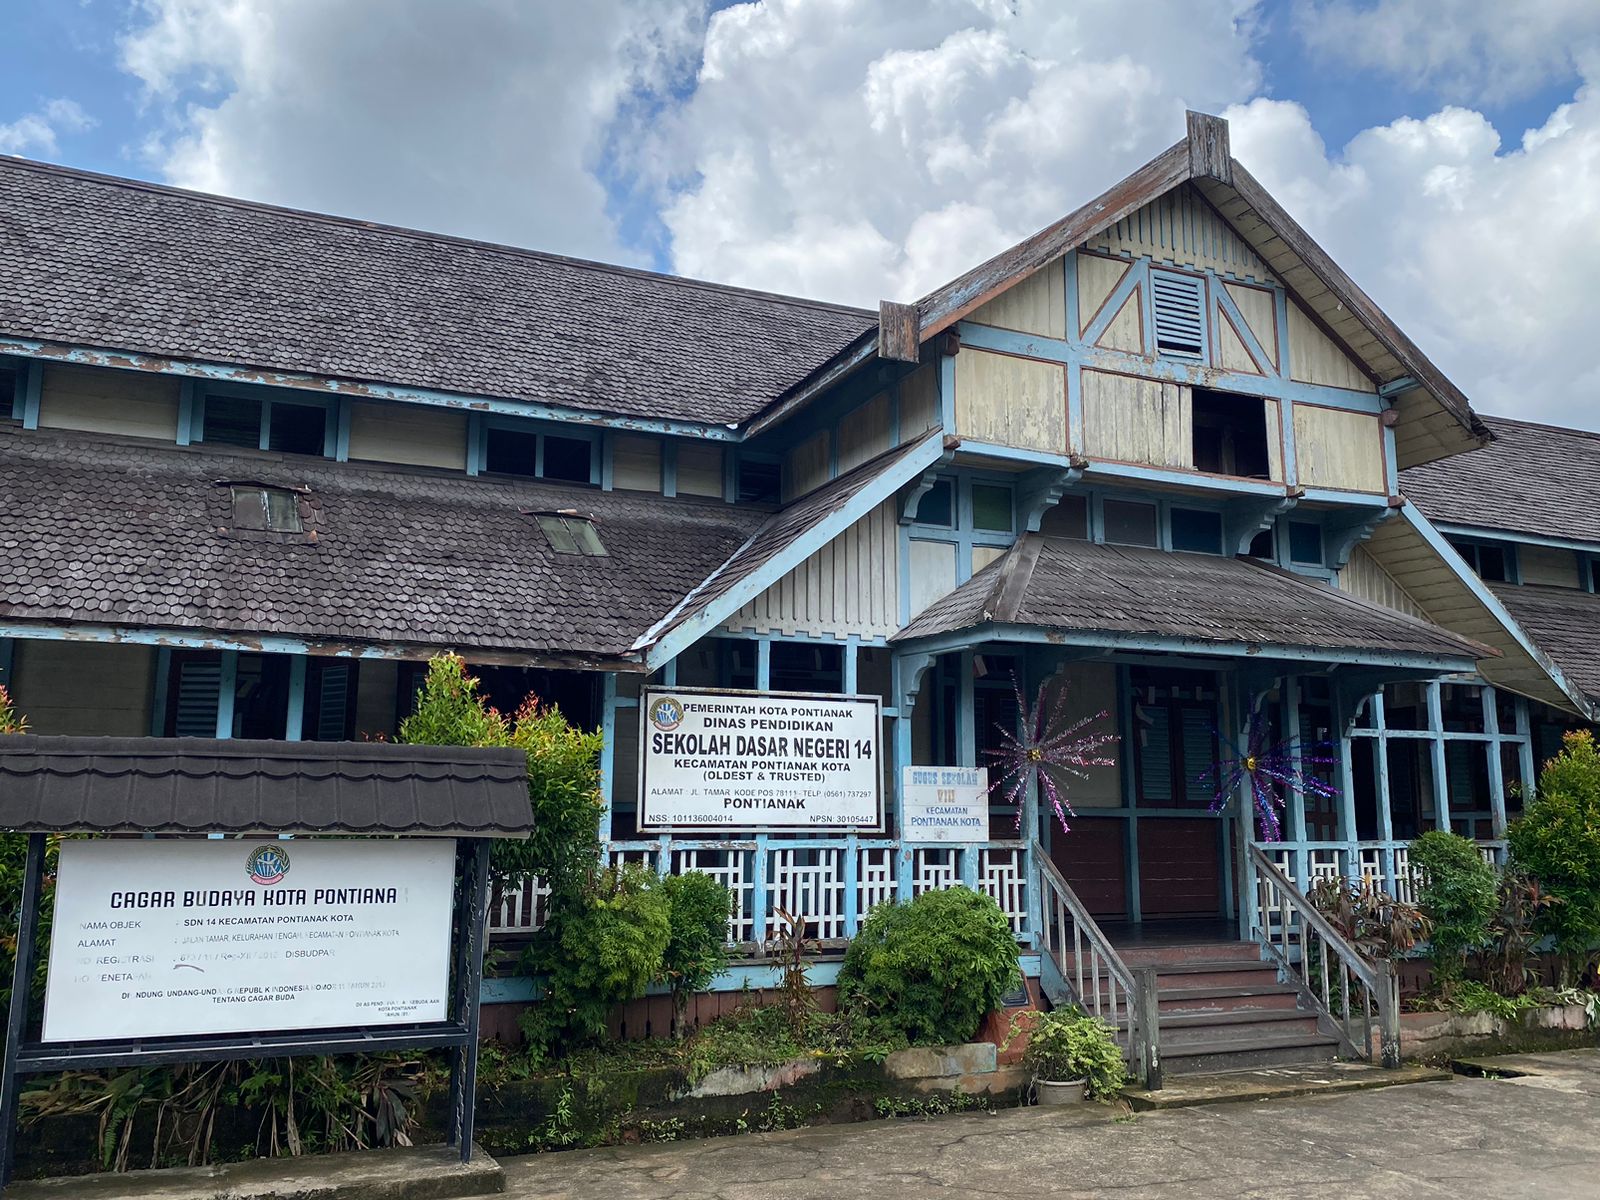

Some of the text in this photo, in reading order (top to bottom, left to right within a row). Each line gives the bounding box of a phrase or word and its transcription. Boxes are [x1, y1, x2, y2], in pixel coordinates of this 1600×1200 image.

[683, 703, 853, 718] PEMERINTAH KOTA PONTIANAK
[703, 717, 834, 732] DINAS PENDIDIKAN
[652, 732, 872, 760] SEKOLAH DASAR NEGERI 14
[674, 759, 851, 772] KECAMATAN PONTIANAK KOTA
[703, 770, 826, 783] (OLDEST & TRUSTED)
[912, 771, 938, 785] GUGUS
[650, 788, 684, 796] ALAMAT
[734, 789, 756, 797] KODE
[757, 789, 774, 797] POS
[723, 797, 806, 810] PONTIANAK
[926, 805, 968, 815] KECAMATAN
[672, 814, 734, 823] 101136004014
[836, 815, 874, 823] 30105447
[911, 816, 982, 827] PONTIANAK KOTA
[110, 891, 176, 909] CAGAR
[183, 889, 256, 907] BUDAYA
[263, 888, 307, 906] KOTA
[80, 921, 108, 930] NAMA
[109, 920, 142, 930] OBJEK
[183, 918, 204, 927] SDN
[206, 917, 216, 926] 14
[218, 915, 275, 926] KECAMATAN
[277, 914, 328, 924] PONTIANAK
[330, 913, 354, 923] KOTA
[77, 938, 116, 948] ALAMAT
[231, 932, 273, 942] KELURAHAN
[212, 995, 247, 1004] TENTANG
[247, 994, 273, 1003] CAGAR
